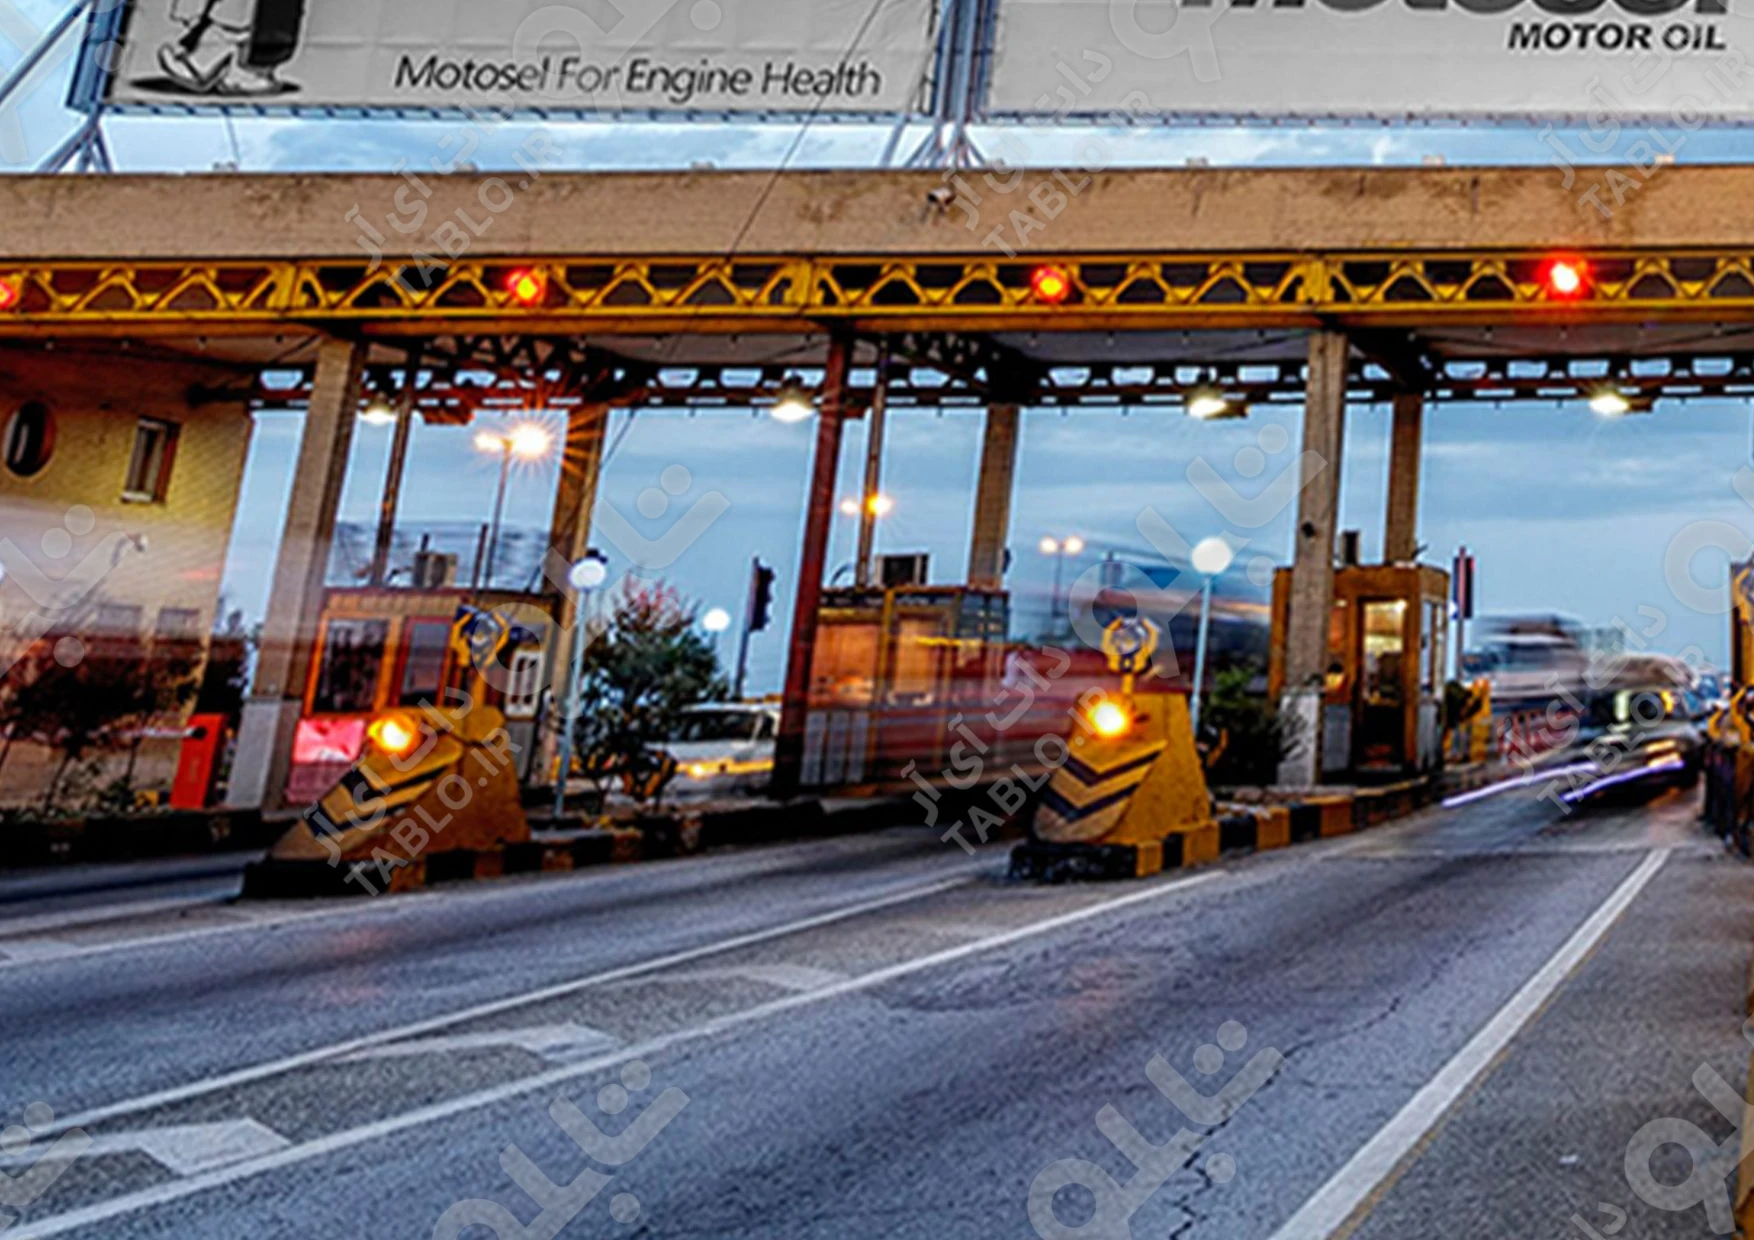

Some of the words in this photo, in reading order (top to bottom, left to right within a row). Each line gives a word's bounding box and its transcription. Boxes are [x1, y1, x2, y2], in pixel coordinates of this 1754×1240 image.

[1507, 22, 1652, 50] MOTOR
[1662, 23, 1728, 51] OIL
[395, 55, 551, 93] Motosel
[557, 56, 622, 92] For
[625, 58, 753, 105] Engine
[761, 61, 882, 97] Health
